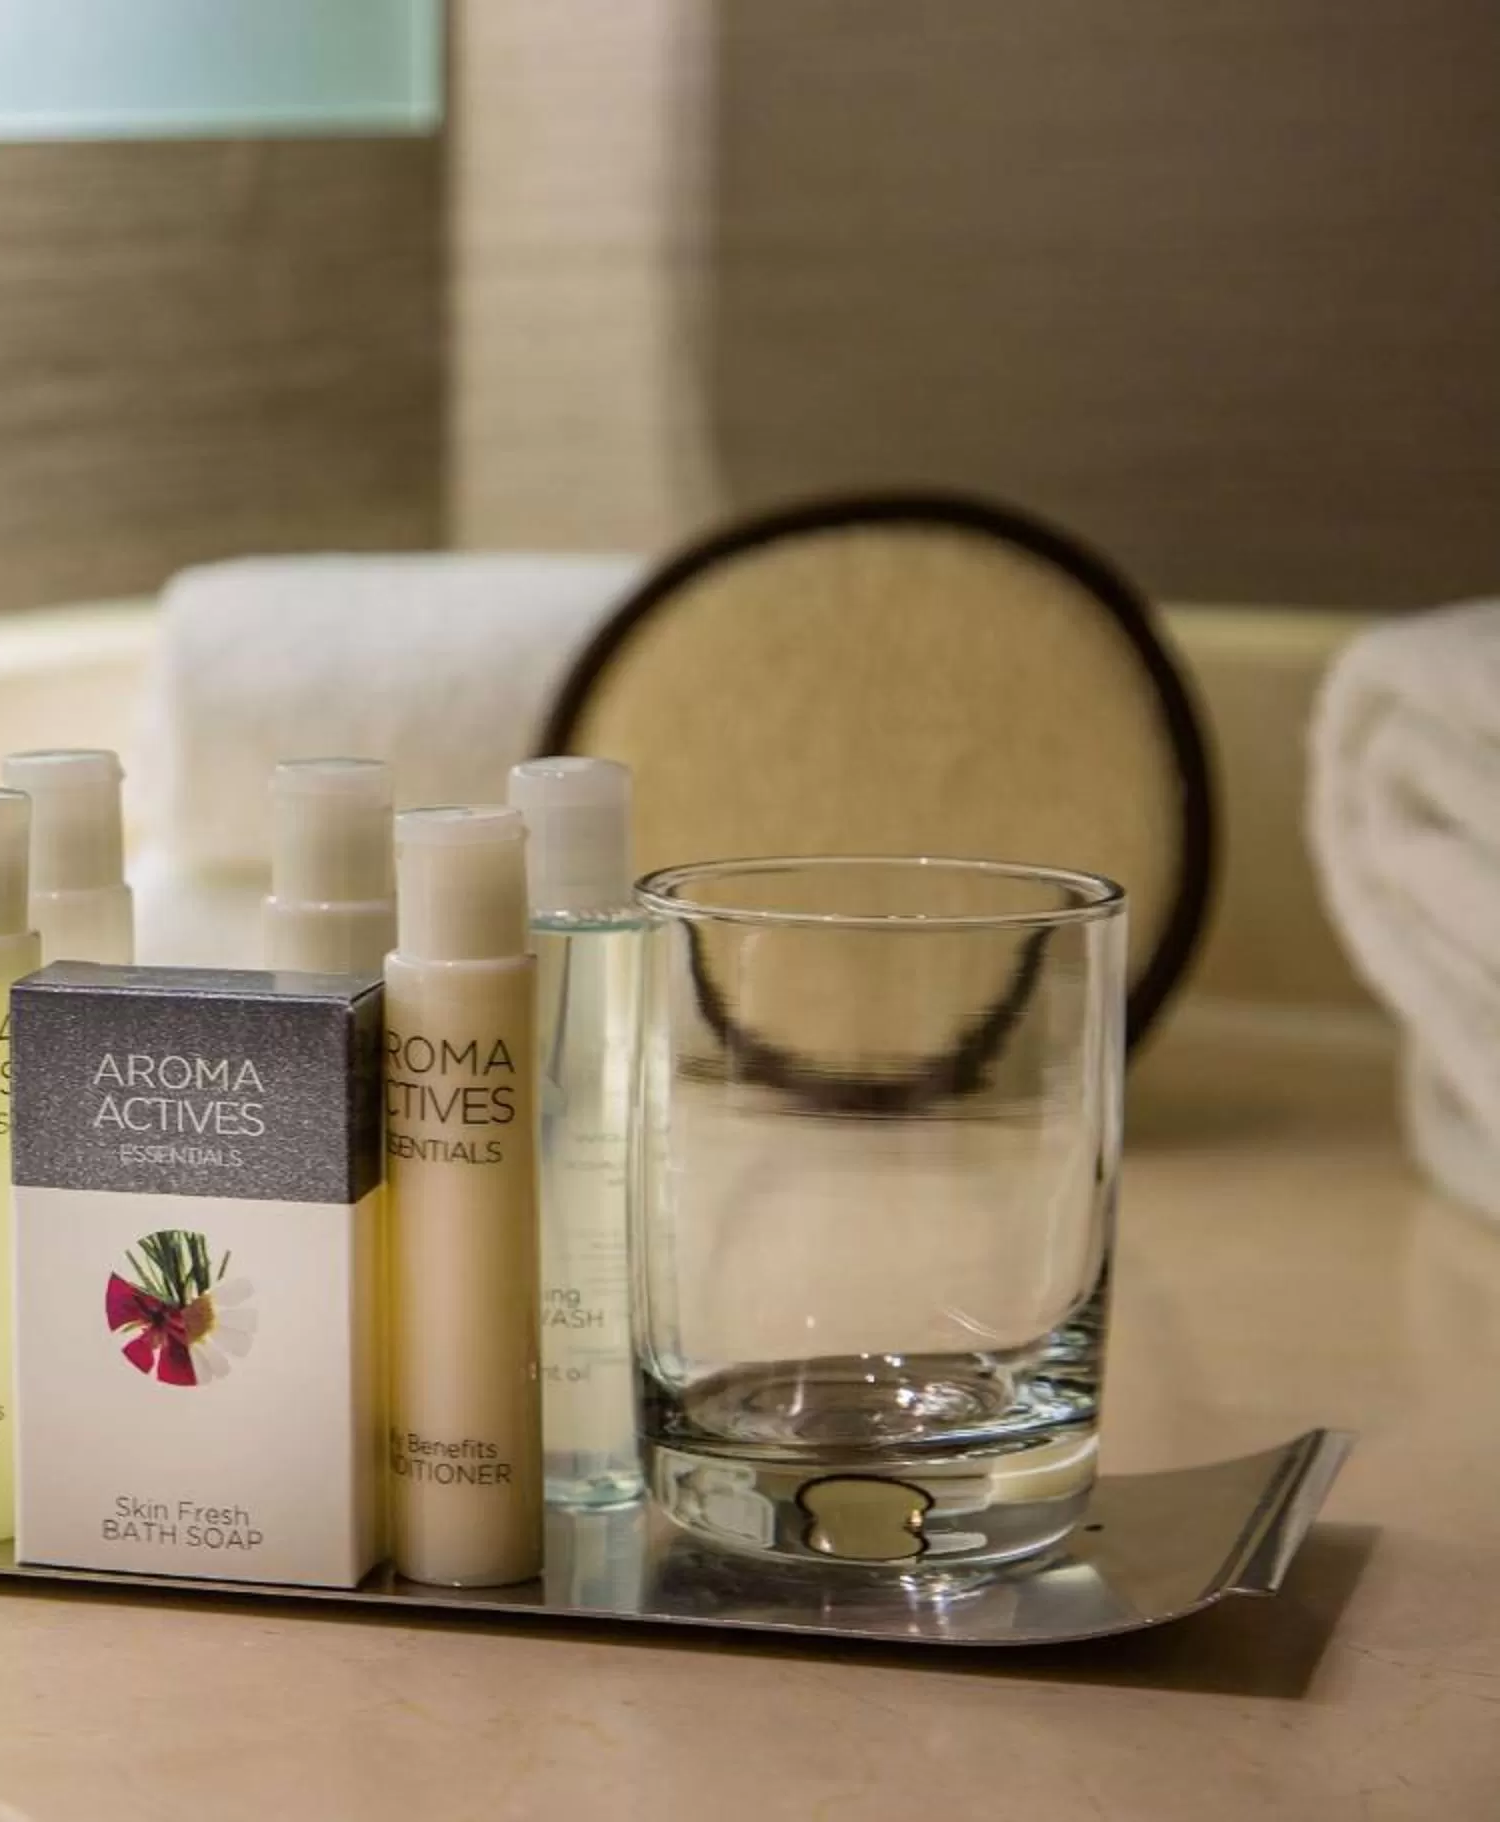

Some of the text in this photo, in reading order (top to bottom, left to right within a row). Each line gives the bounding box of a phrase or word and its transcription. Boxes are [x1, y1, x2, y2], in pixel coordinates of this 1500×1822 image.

[386, 1030, 516, 1076] ROMA
[92, 1053, 266, 1092] AROMA
[92, 1095, 266, 1137] ACTIVES
[386, 1079, 516, 1125] CTIVES
[118, 1143, 244, 1168] ESSENTIALS
[407, 1432, 499, 1459] Benefits
[115, 1496, 250, 1526] Skin Fresh
[102, 1519, 263, 1550] BATH SOAP
